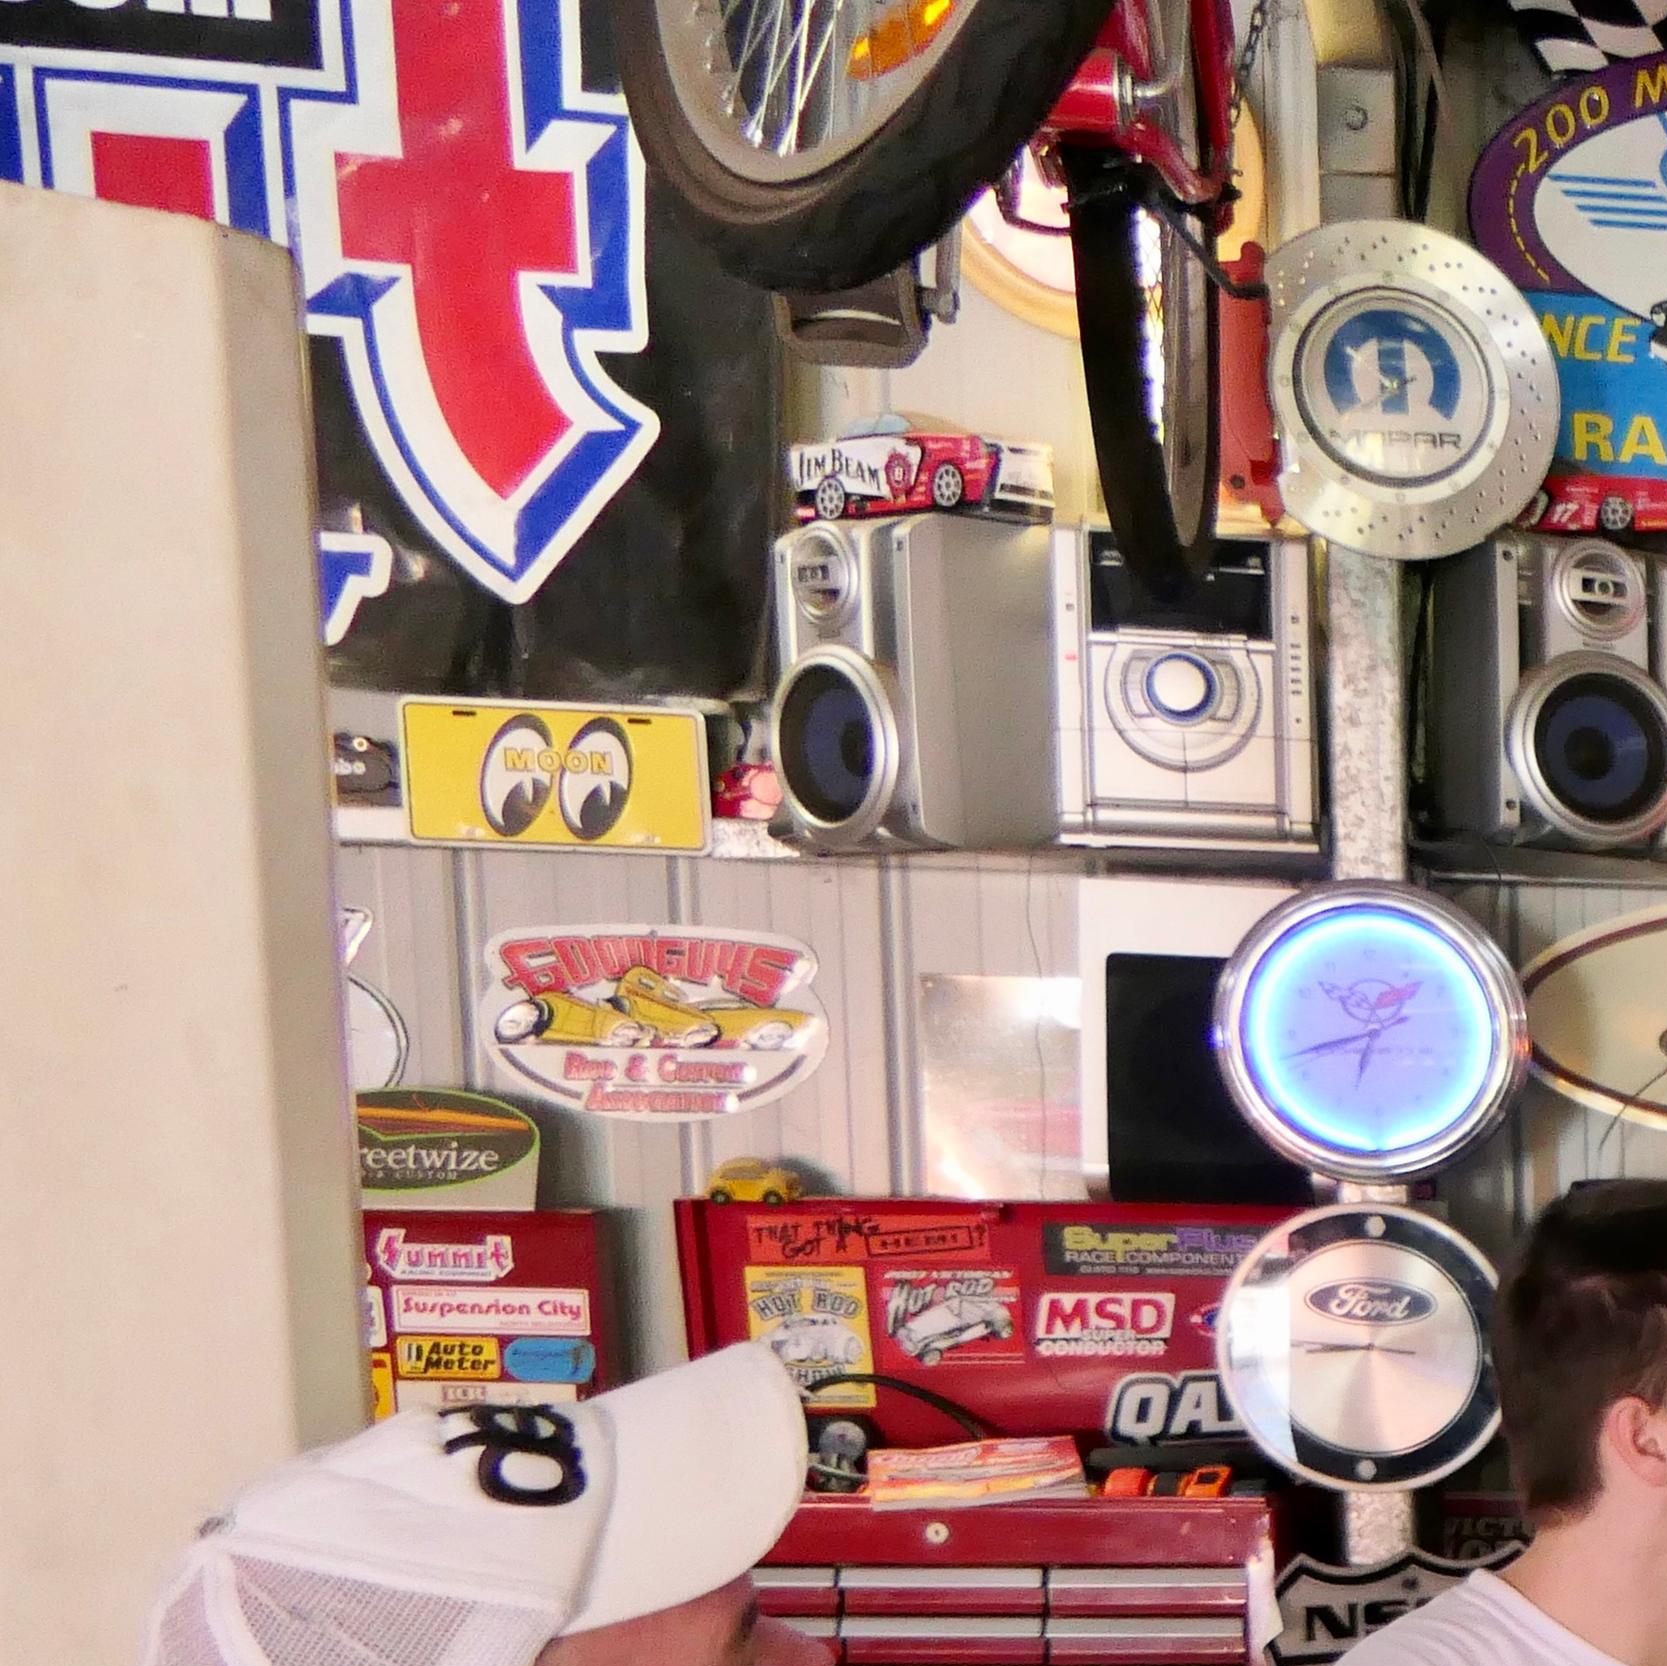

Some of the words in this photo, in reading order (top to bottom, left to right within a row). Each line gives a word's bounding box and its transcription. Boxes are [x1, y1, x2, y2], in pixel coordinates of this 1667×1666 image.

[1516, 88, 1610, 172] 200
[1541, 316, 1637, 365] NCE
[1331, 432, 1463, 451] MOPAR
[829, 450, 884, 491] BEAM
[503, 745, 613, 776] MOON
[500, 936, 808, 1005] GOODGUYS
[626, 1056, 649, 1081] &
[1062, 1225, 1178, 1262] Super
[1065, 1252, 1117, 1265] RACE
[403, 1296, 532, 1318] Suspension
[538, 1299, 583, 1321] City
[1044, 1298, 1168, 1335] MSD
[1332, 1283, 1413, 1323] Ford
[1038, 1340, 1168, 1356] CONDUCTOR
[1080, 1328, 1137, 1341] SUPER
[429, 1341, 484, 1357] Auto
[425, 1355, 496, 1373] Meter
